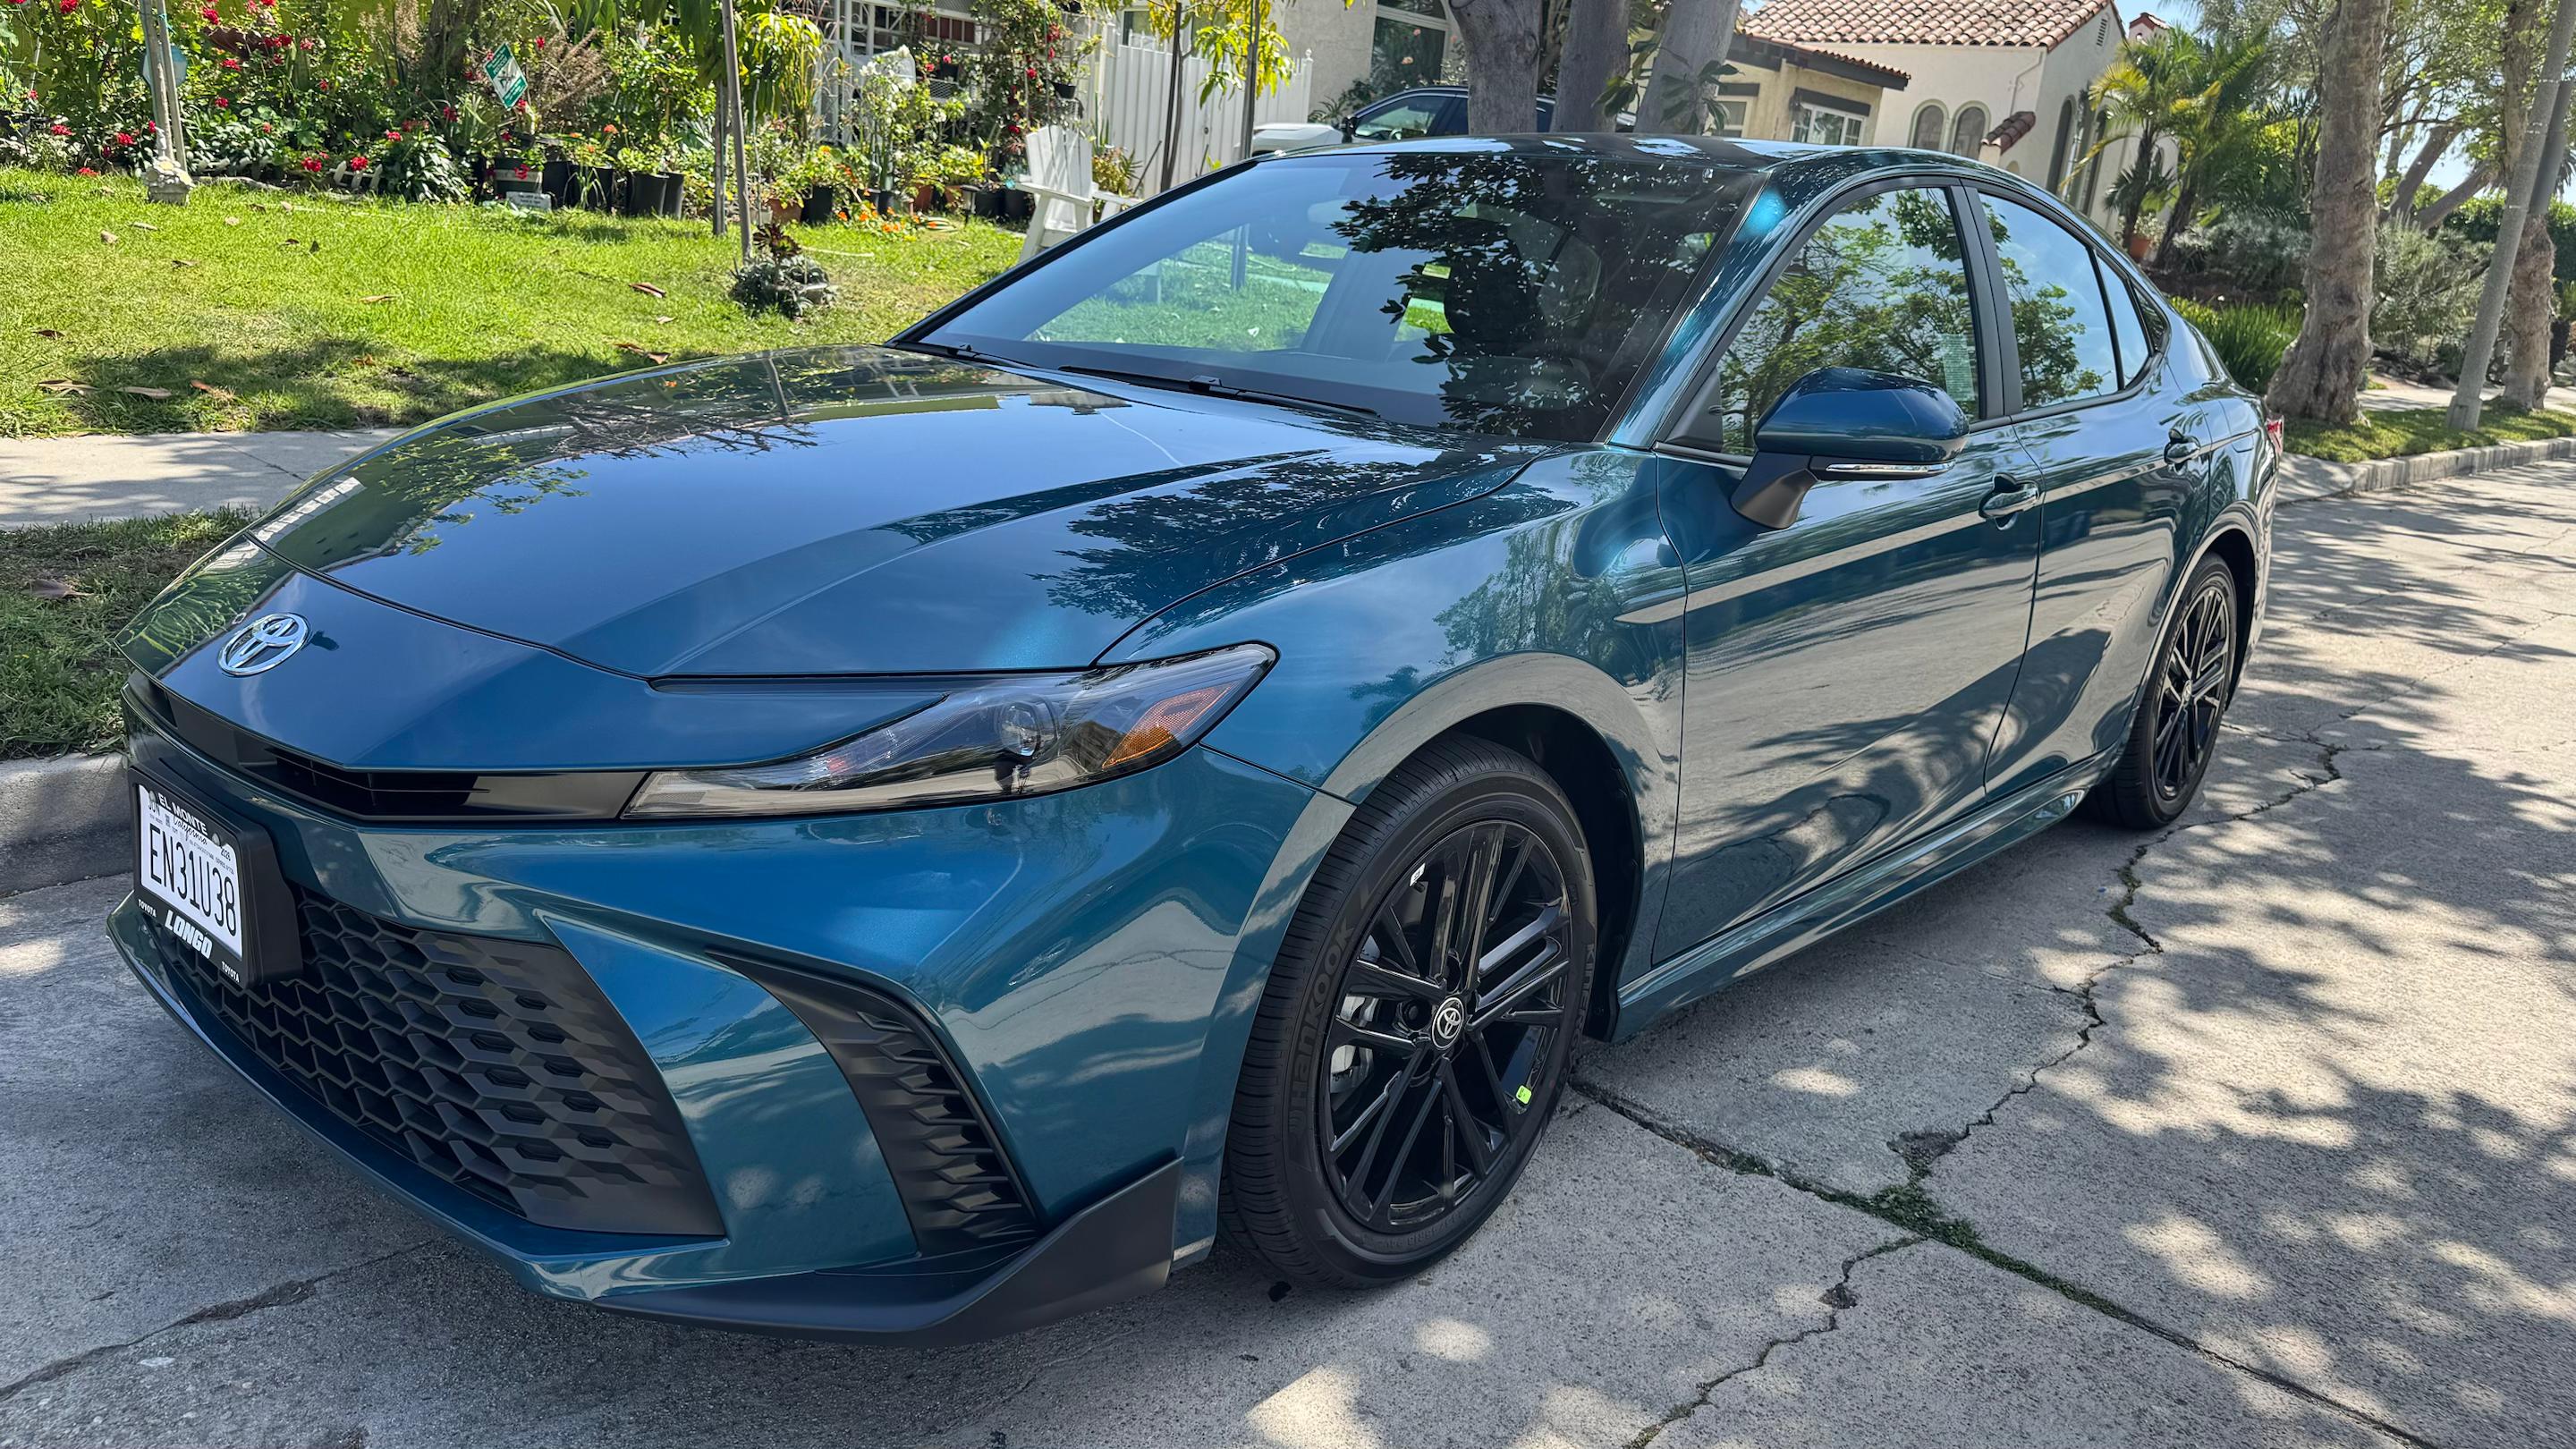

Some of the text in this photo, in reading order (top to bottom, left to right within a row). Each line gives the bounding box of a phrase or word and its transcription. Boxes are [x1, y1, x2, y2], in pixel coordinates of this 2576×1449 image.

[157, 792, 172, 811] EL
[172, 802, 208, 836] MONTE
[150, 823, 237, 936] EN31U38
[138, 898, 157, 918] TOYOTA
[165, 910, 213, 959] LONGO
[221, 961, 240, 982] TOYOTA
